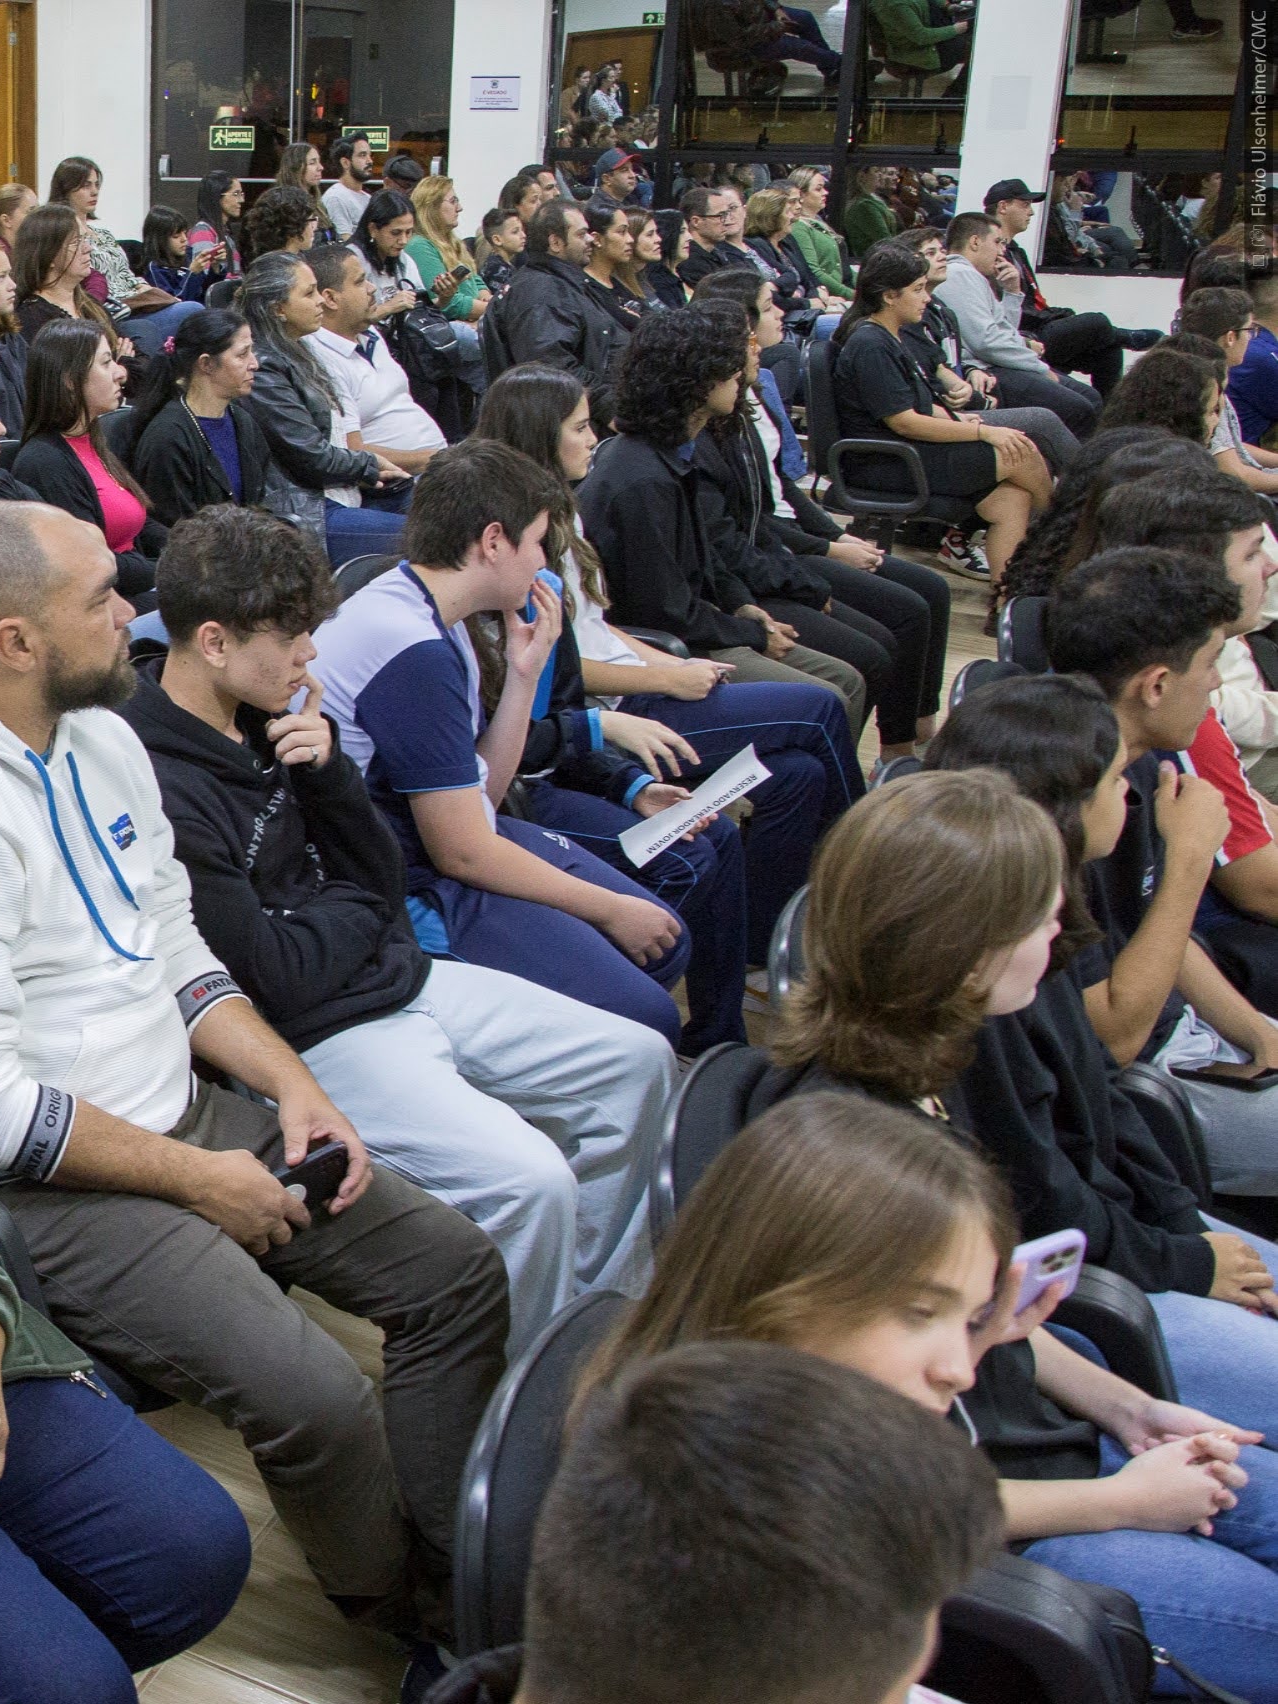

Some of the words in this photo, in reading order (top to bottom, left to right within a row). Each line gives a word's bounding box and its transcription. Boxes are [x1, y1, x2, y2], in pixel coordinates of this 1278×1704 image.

[713, 773, 758, 808] RESERVADO
[672, 804, 714, 835] VEREADOR
[646, 831, 674, 854] JOVEM
